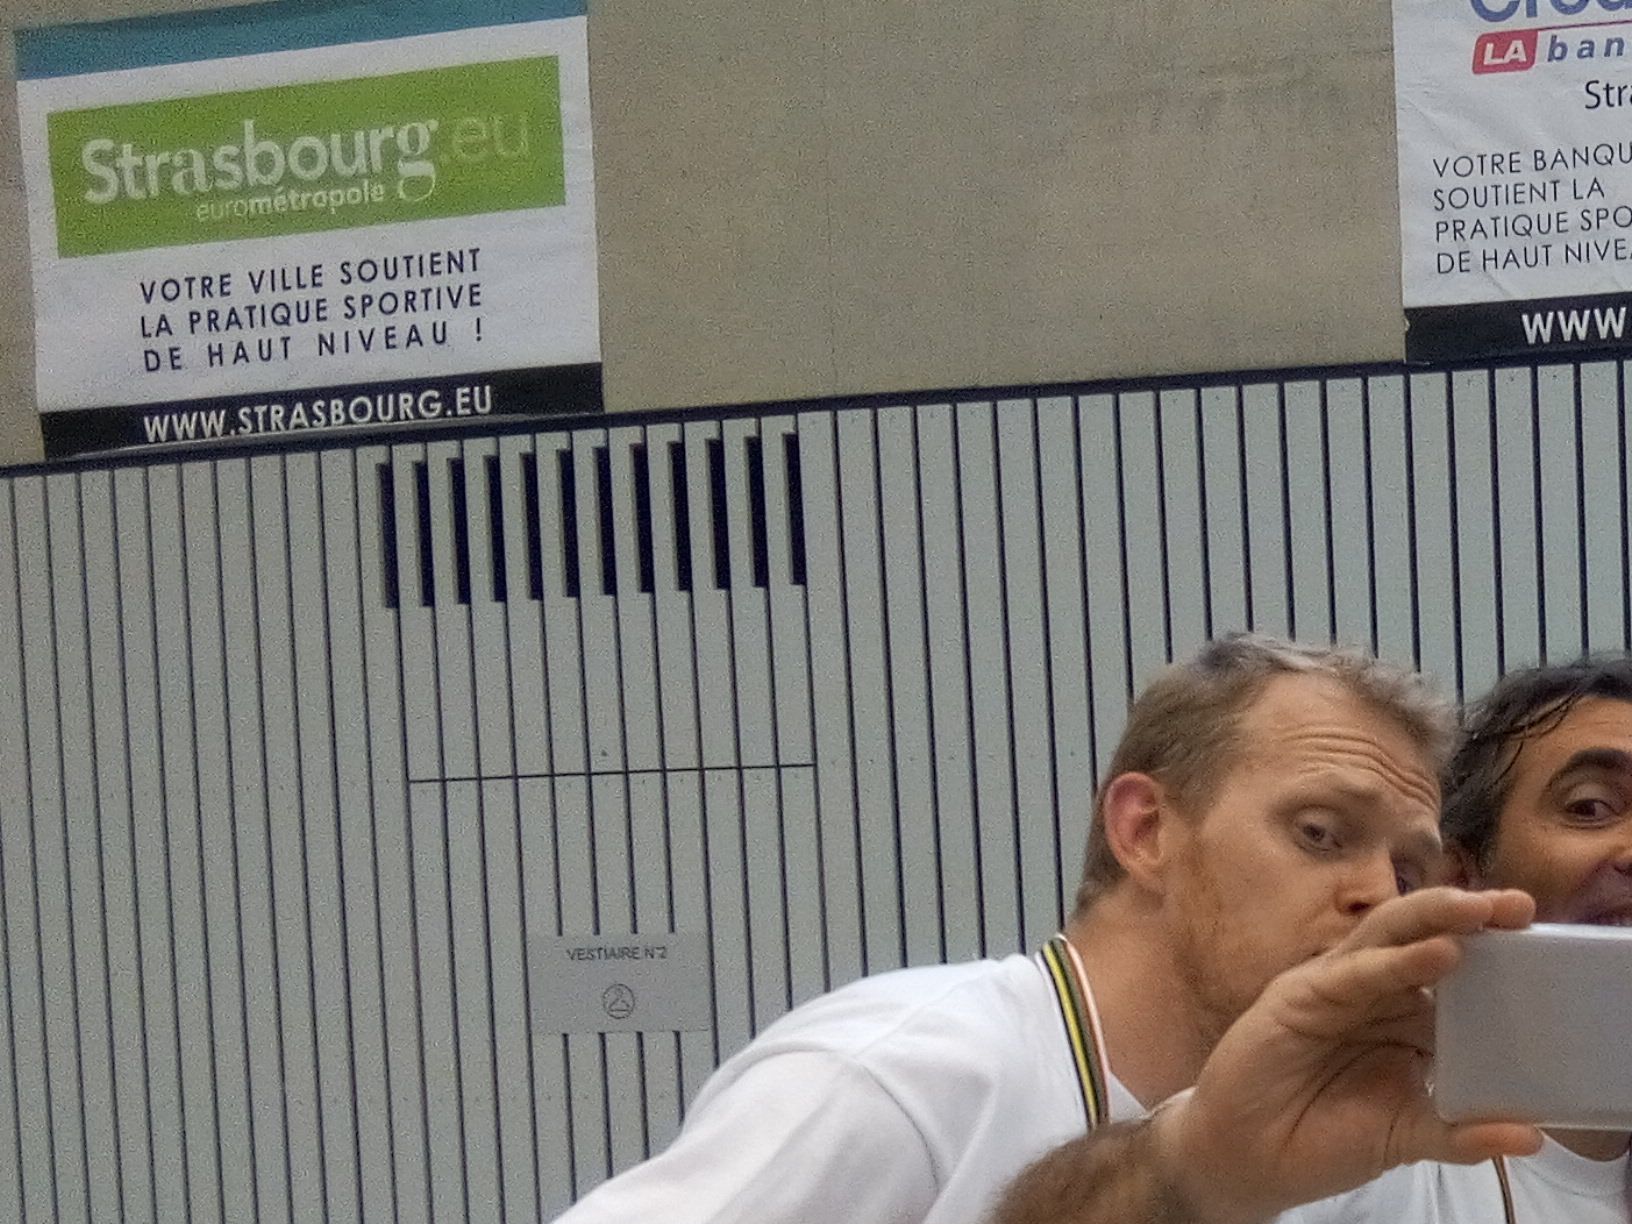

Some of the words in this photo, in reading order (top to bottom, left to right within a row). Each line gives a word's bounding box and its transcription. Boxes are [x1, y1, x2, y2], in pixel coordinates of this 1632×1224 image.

[1483, 40, 1527, 65] LA
[82, 112, 529, 204] Strasbourg.eu
[1433, 151, 1521, 178] VOTRE
[197, 179, 385, 221] eurométropole
[1433, 180, 1560, 212] SOUTIENT
[1573, 176, 1605, 200] LA
[1436, 211, 1569, 243] PRATIQUE
[140, 273, 231, 304] VOTRE
[248, 264, 323, 294] VILLE
[340, 248, 480, 285] SOUTIENT
[1437, 251, 1471, 275] DE
[1482, 244, 1552, 272] HAUT
[141, 313, 173, 338] LA
[189, 298, 327, 334] PRATIQUE
[344, 283, 481, 319] SPORTIVE
[144, 346, 182, 372] DE
[207, 336, 291, 367] HAUT
[318, 320, 447, 356] NIVEAU
[475, 317, 482, 342] !
[143, 385, 492, 443] WWW.STRASBOURG.EU
[566, 946, 640, 961] VESTIAIRE
